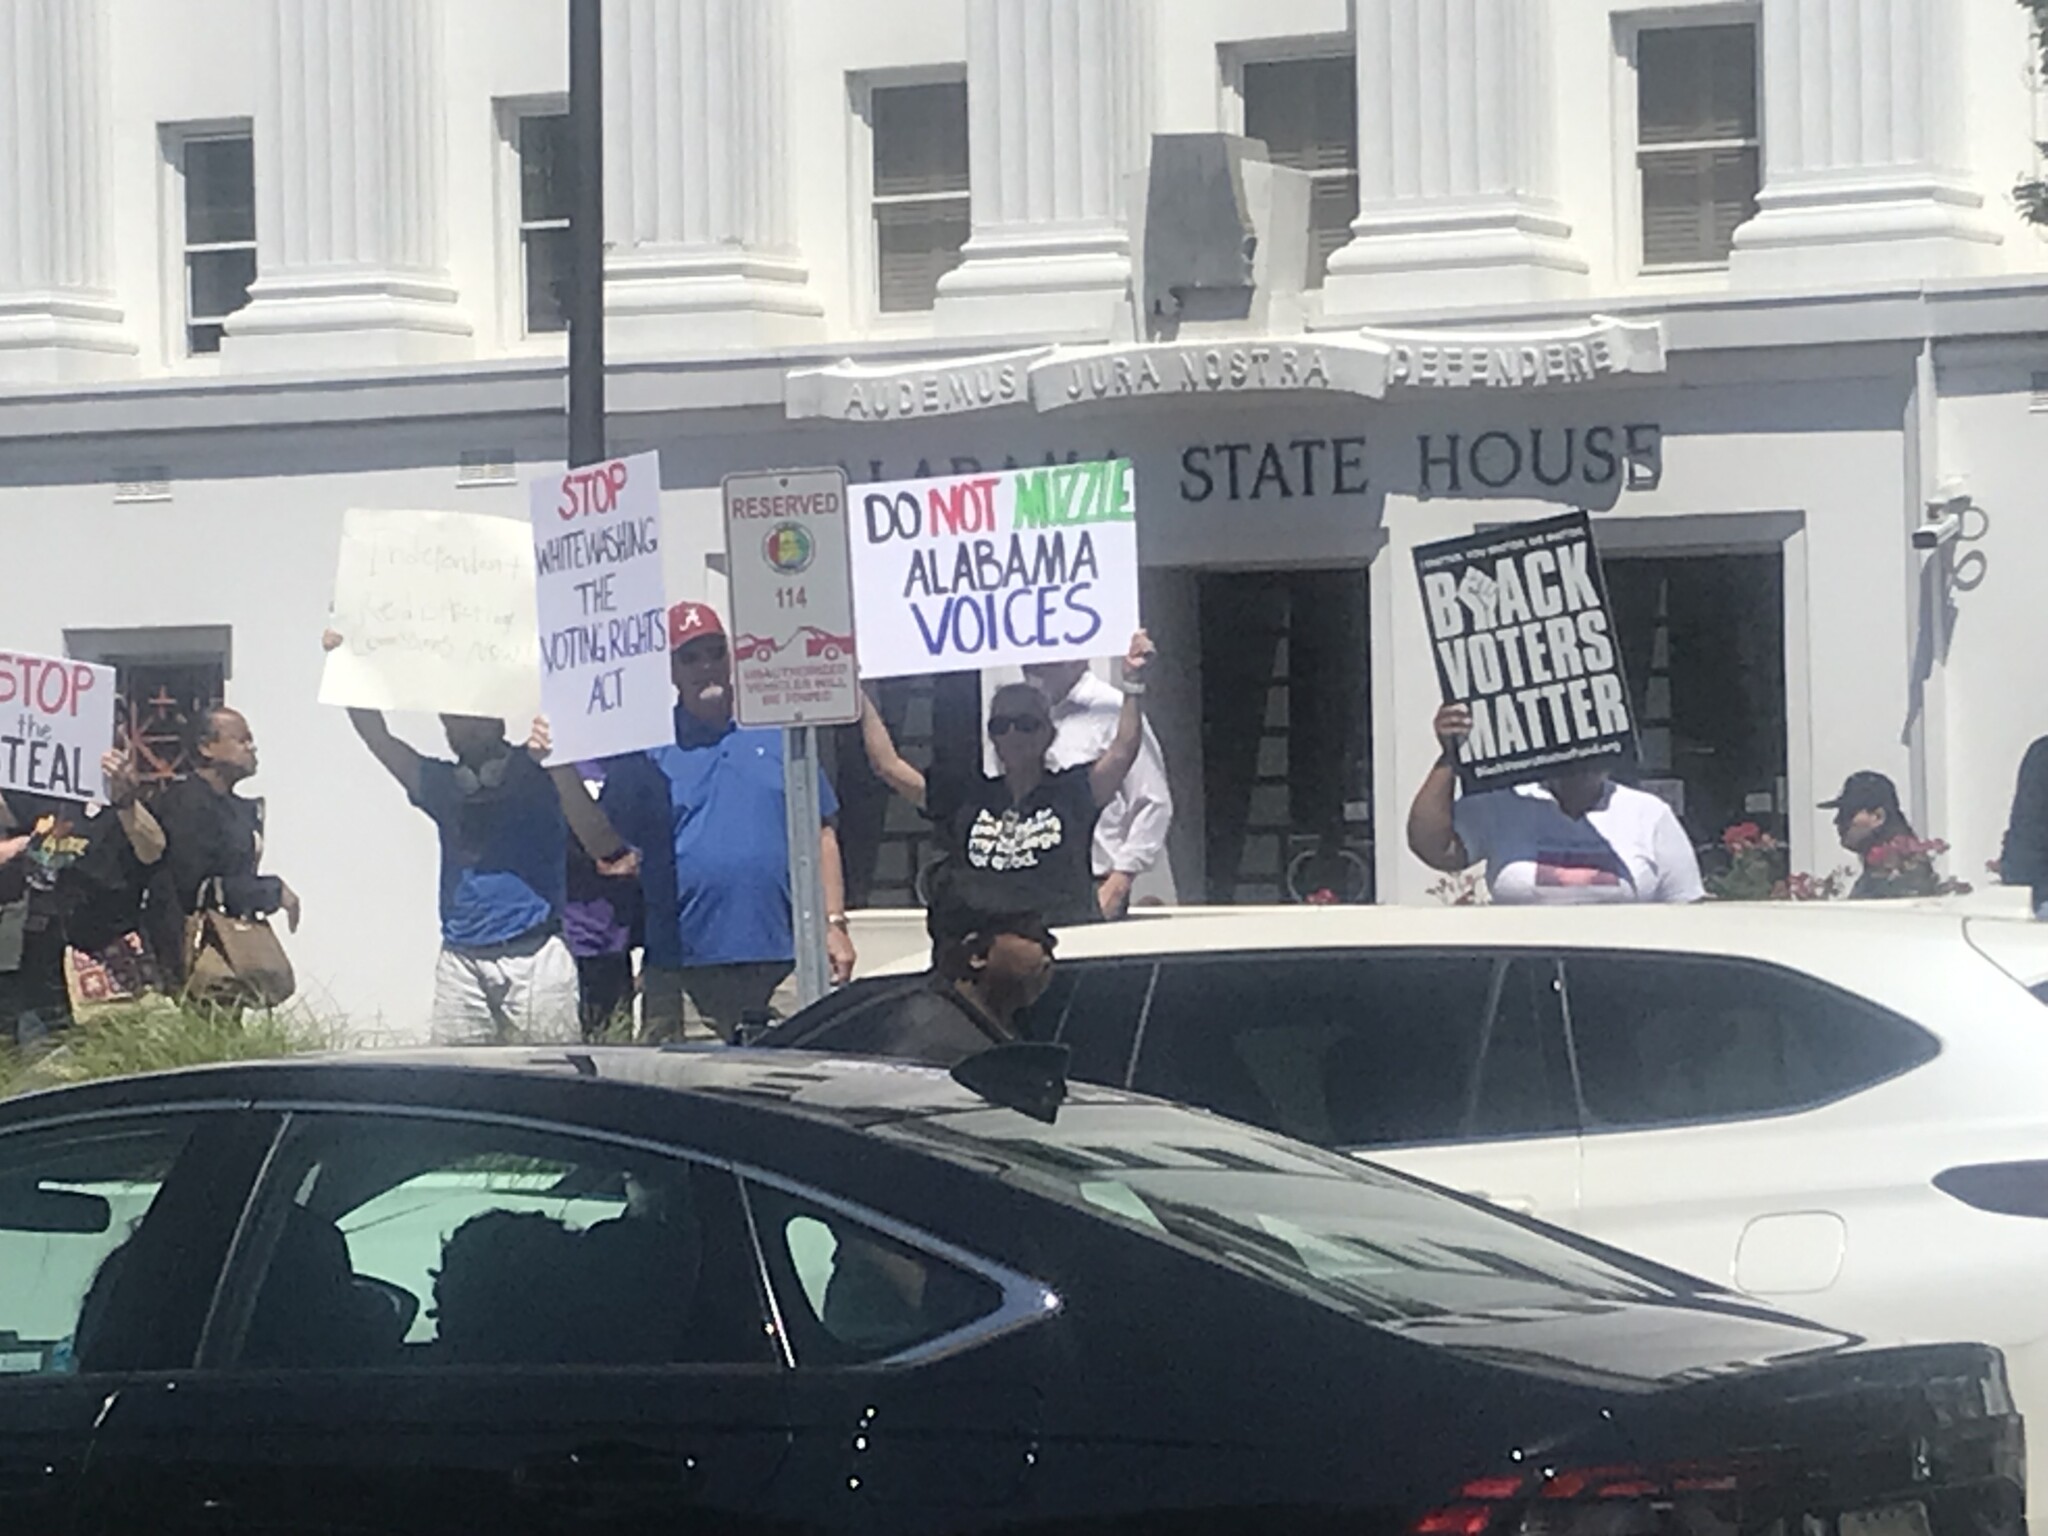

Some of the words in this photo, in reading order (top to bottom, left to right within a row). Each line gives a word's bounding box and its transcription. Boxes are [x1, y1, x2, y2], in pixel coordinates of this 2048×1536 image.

[844, 363, 1017, 418] AUDEMUS
[1067, 354, 1161, 400] JURA
[1181, 347, 1332, 391] NOSTRA
[1389, 340, 1612, 388] DEFENDERE
[558, 462, 627, 521] STOP
[1180, 436, 1369, 502] STATE
[1416, 423, 1661, 493] HOUSE
[732, 492, 840, 519] RESERVED
[864, 492, 921, 544] DO
[928, 478, 999, 538] NOT
[574, 573, 617, 616] THE
[903, 530, 1099, 598] ALABAMA
[1423, 542, 1600, 640] BACK
[775, 586, 807, 609] 114
[910, 582, 1101, 656] VOICES
[540, 621, 606, 676] VOTING
[608, 606, 666, 662] RIGHTS
[1438, 609, 1615, 699] VOTERS
[0, 654, 95, 717] STOP
[587, 667, 625, 715] ACT
[18, 713, 52, 741] the
[1459, 673, 1630, 765] MATTER
[0, 735, 95, 797] TEAL
